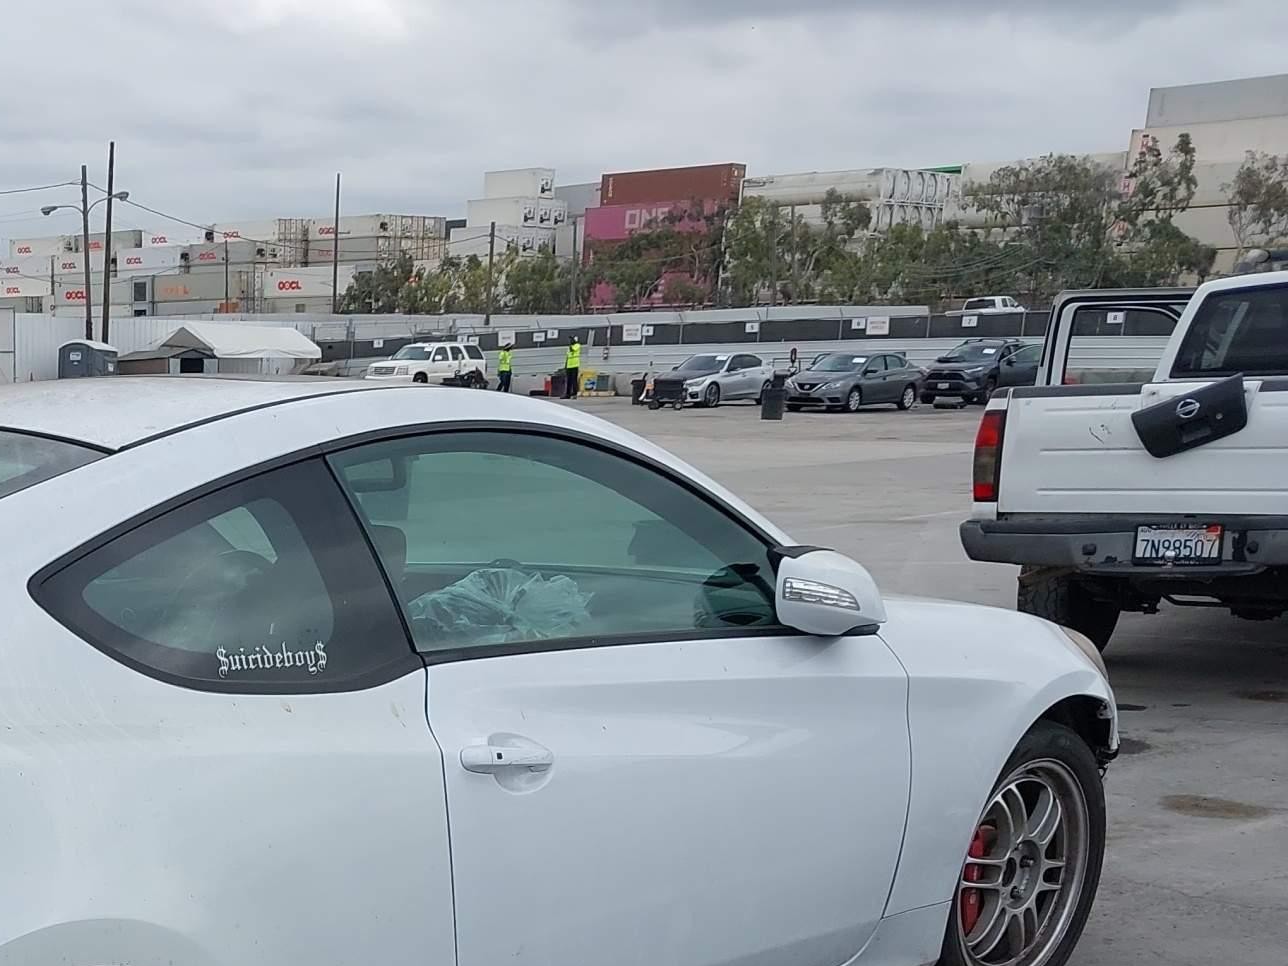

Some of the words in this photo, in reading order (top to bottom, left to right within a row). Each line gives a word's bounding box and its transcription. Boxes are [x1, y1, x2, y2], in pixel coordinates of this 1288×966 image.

[151, 236, 167, 244] OOCL
[17, 246, 32, 254] OOCL
[199, 252, 216, 260] OOCL
[278, 281, 302, 290] OOCL
